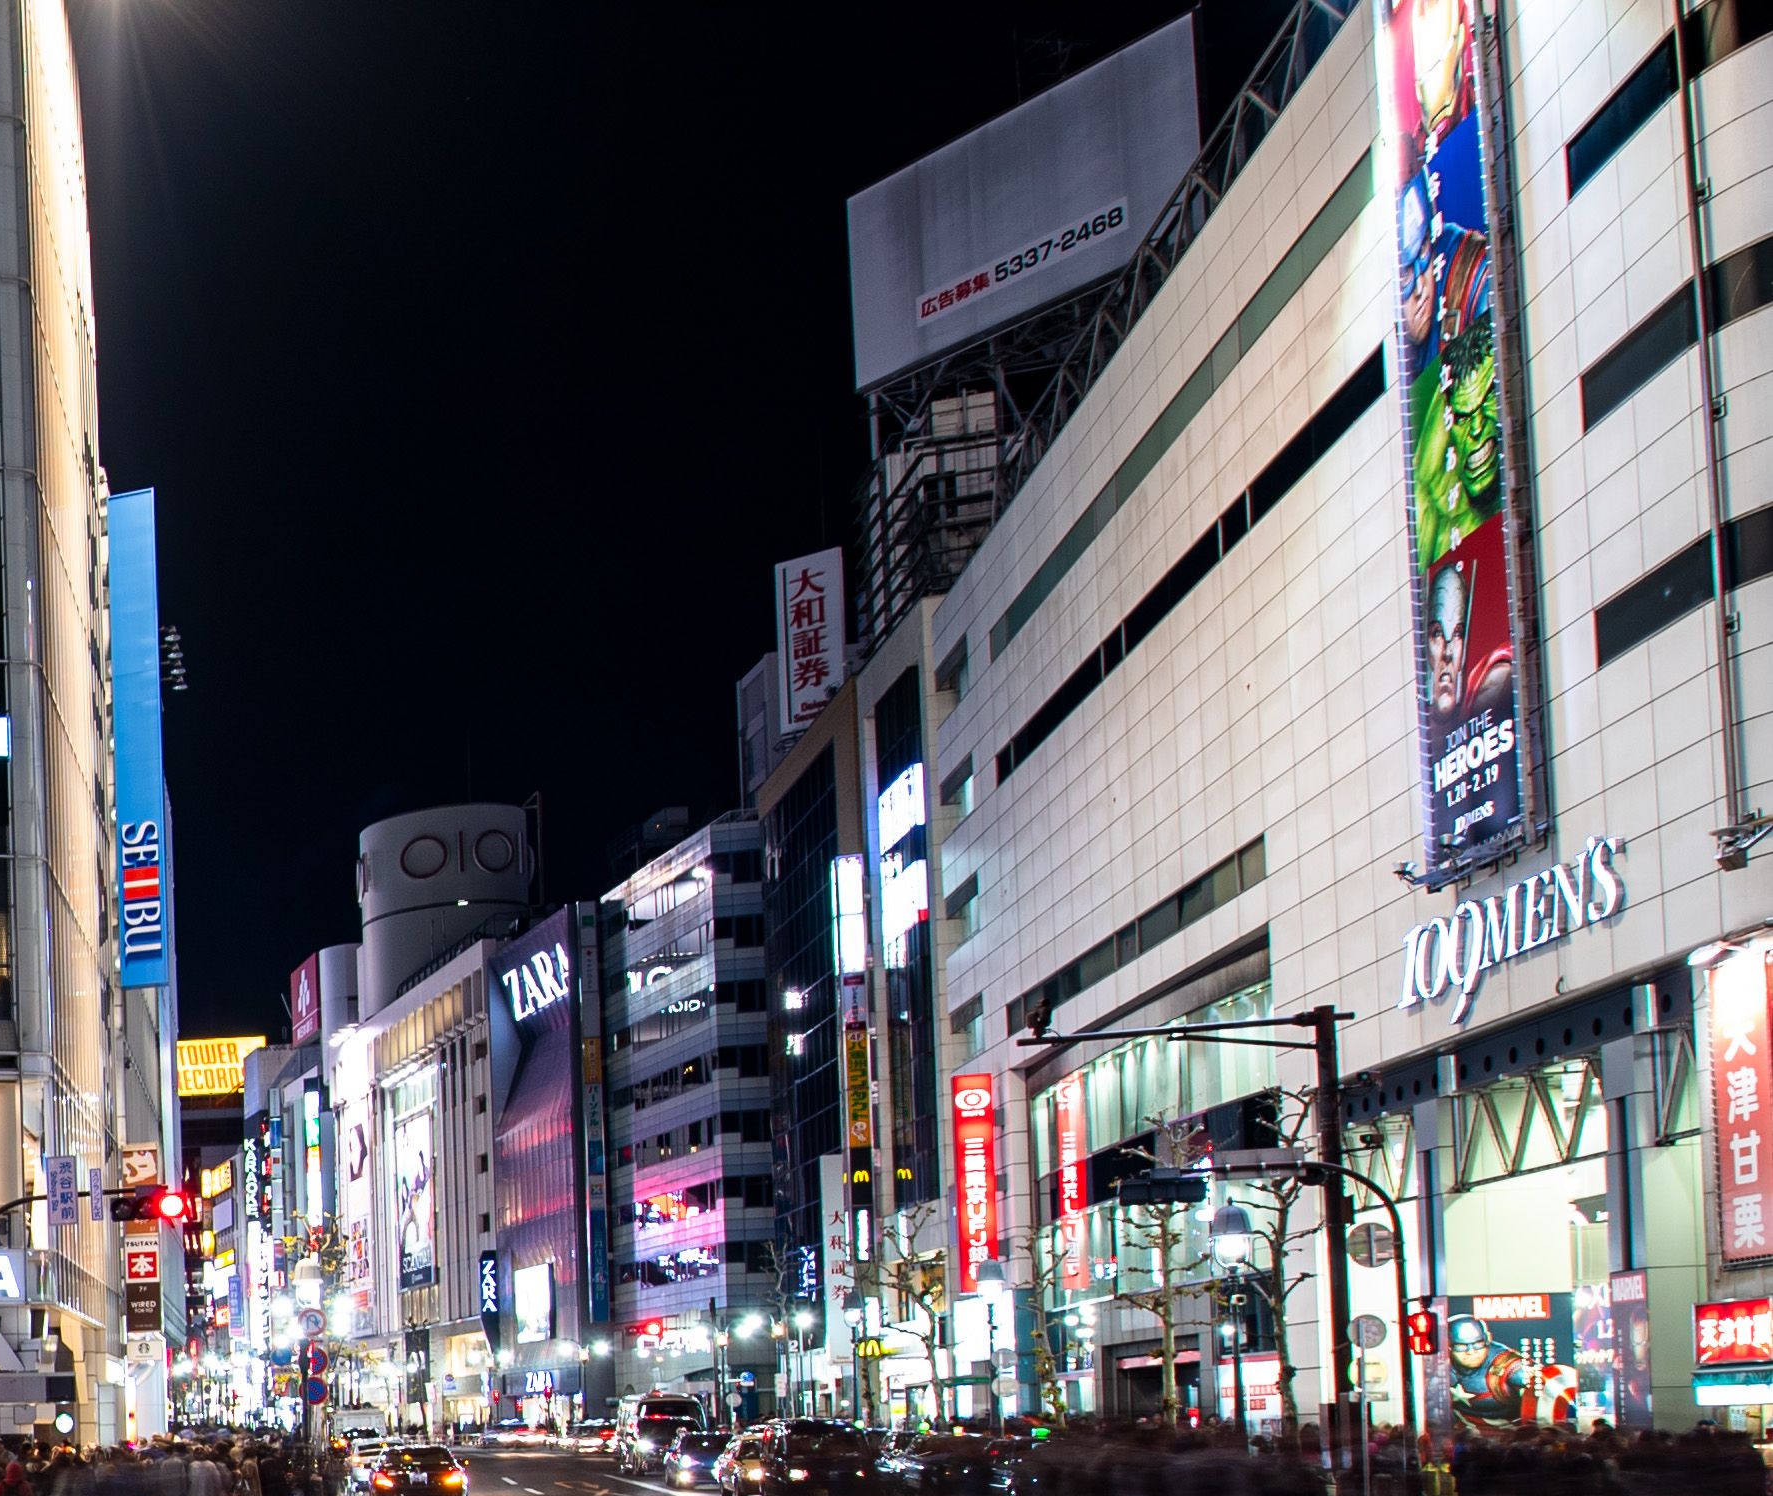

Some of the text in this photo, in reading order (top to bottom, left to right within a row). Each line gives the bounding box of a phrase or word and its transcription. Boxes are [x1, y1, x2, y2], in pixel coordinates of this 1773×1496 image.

[920, 205, 1125, 319] 広告募集 5337-2468
[788, 567, 831, 692] 大和証券
[1467, 708, 1494, 736] THE
[1433, 718, 1515, 793] HEROES
[121, 821, 163, 964] SEIBU
[502, 942, 571, 1022] ZARA
[178, 1042, 238, 1066] TOWER
[178, 1067, 245, 1091] ECORD
[59, 1161, 75, 1220] 渋谷駅前
[244, 1138, 259, 1218] KARAOKE
[131, 1254, 154, 1276] 本
[481, 1259, 498, 1313] ZARA
[1612, 1275, 1645, 1302] MARVEL
[131, 1301, 157, 1309] WIRED
[1473, 1295, 1548, 1319] MARVEL
